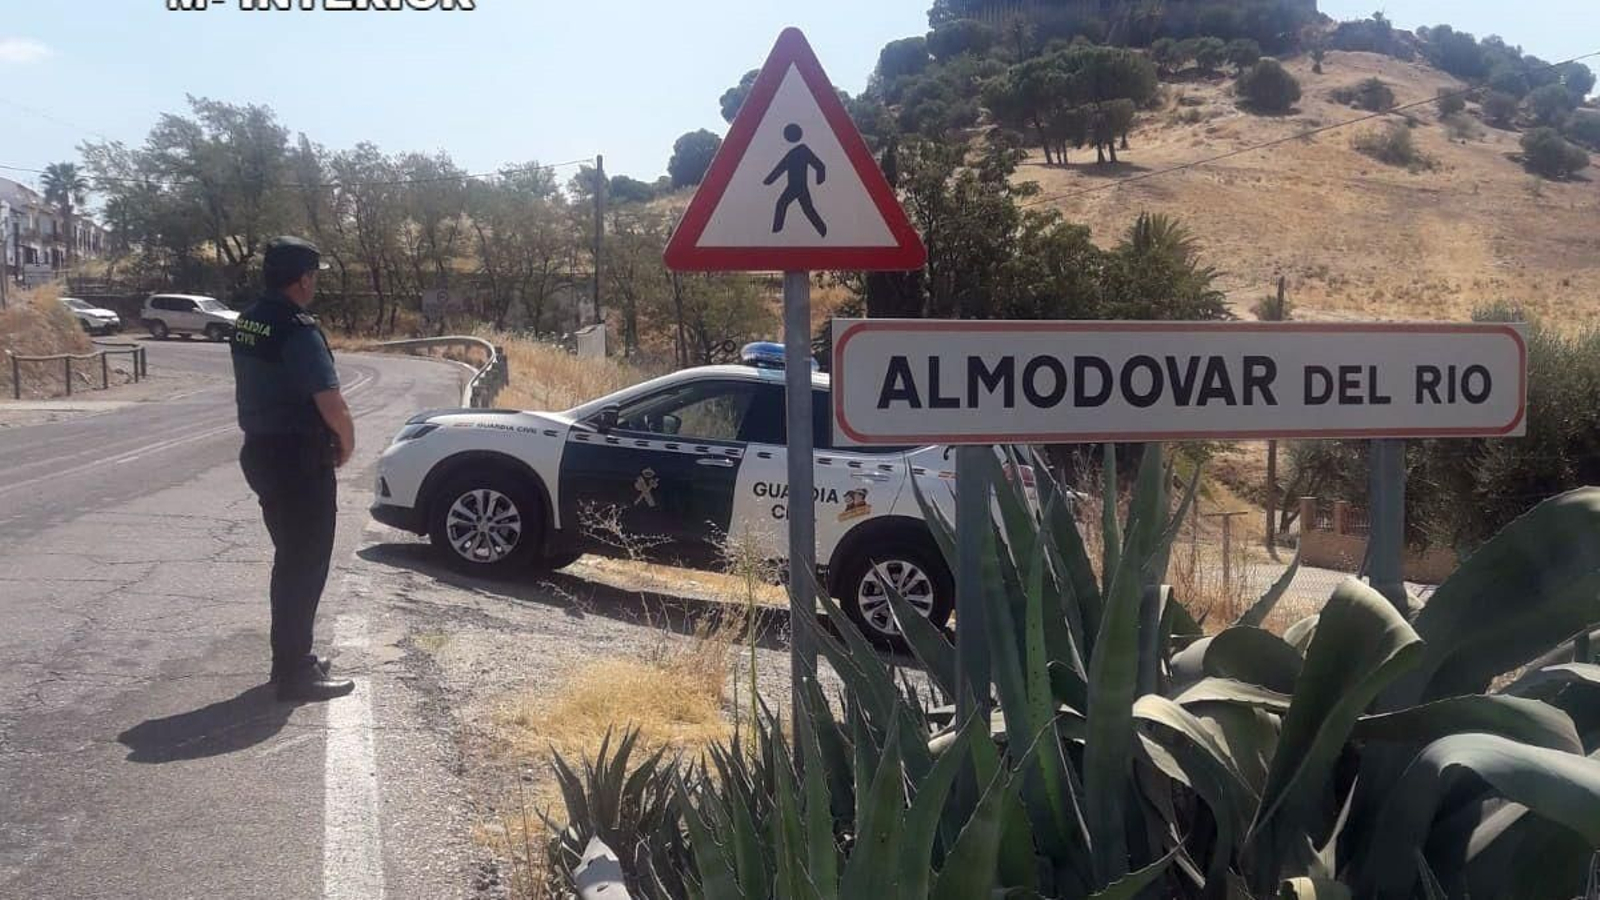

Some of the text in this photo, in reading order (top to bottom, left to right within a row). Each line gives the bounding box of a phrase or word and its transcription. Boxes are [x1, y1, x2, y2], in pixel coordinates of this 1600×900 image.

[877, 355, 1492, 409] ALMODOVAR DEL RIO
